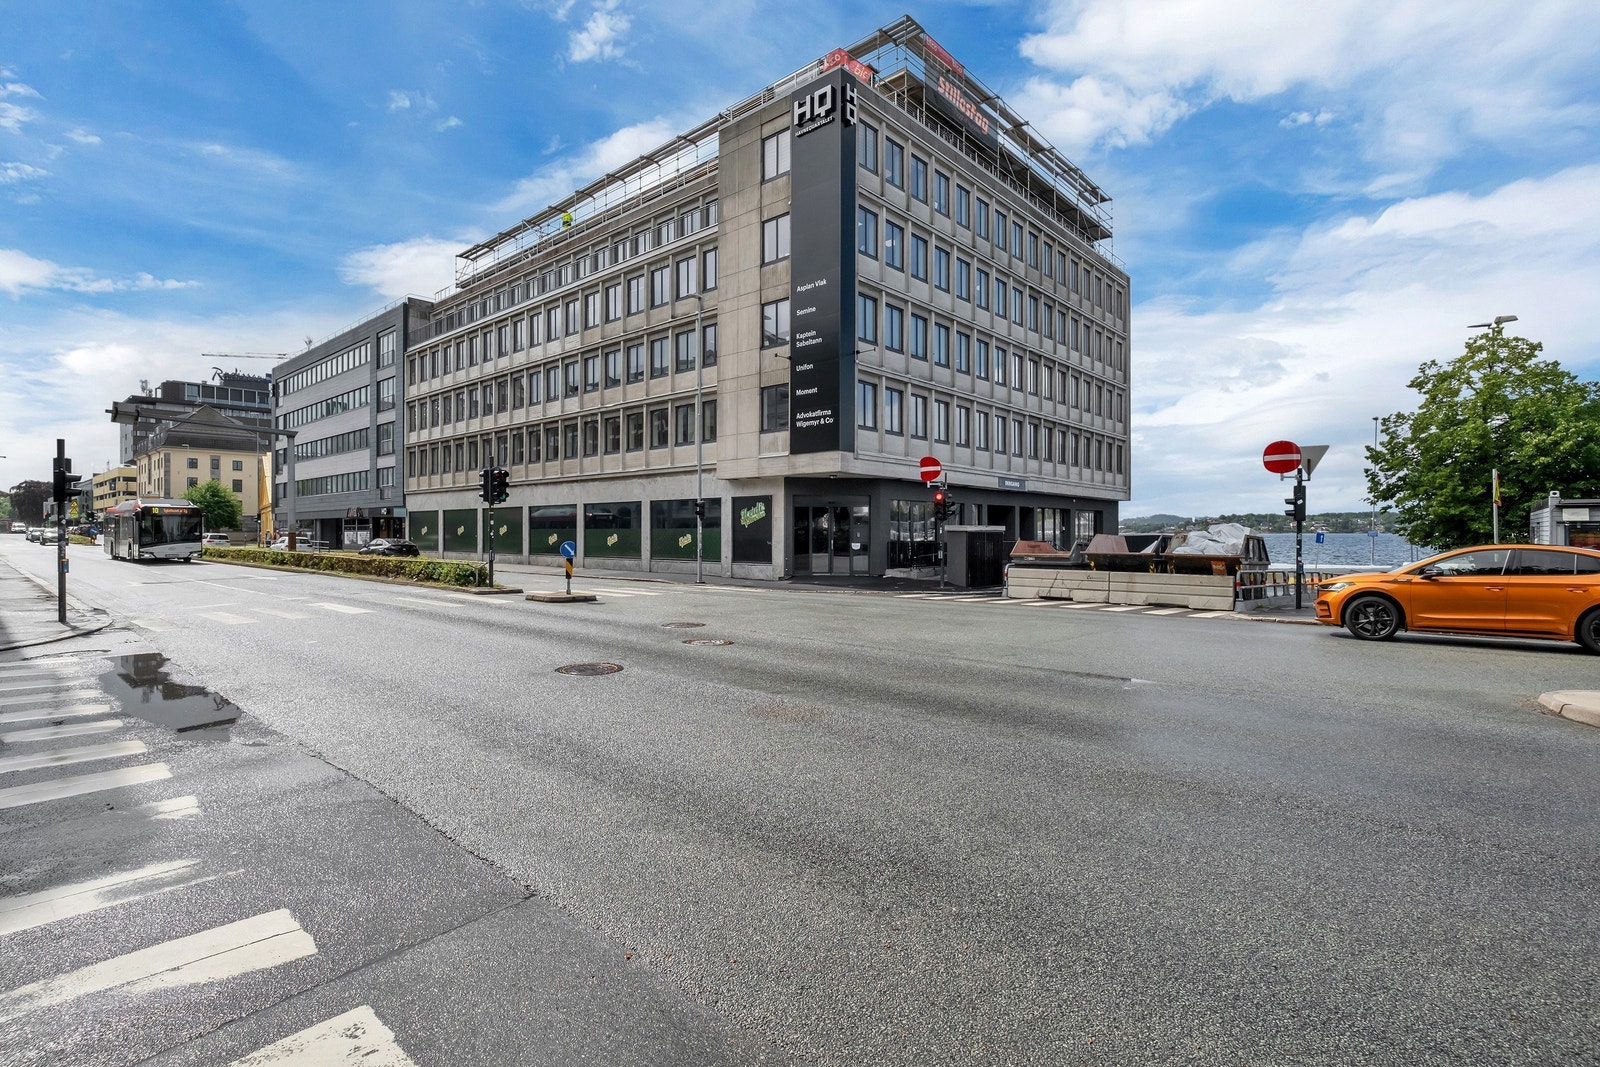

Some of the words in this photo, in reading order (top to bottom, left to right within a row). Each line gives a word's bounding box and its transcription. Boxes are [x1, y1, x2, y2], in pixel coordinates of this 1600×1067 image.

[794, 84, 832, 126] HQ
[796, 283, 815, 293] Asplan
[815, 278, 827, 287] Viak
[796, 306, 817, 316] Semine
[796, 330, 817, 340] Kaptein
[796, 338, 823, 348] Sabeltann
[795, 363, 814, 372] Unifon
[795, 387, 818, 396] Moment
[796, 409, 832, 420] Advokatfirma
[796, 419, 820, 428] Wigemyr
